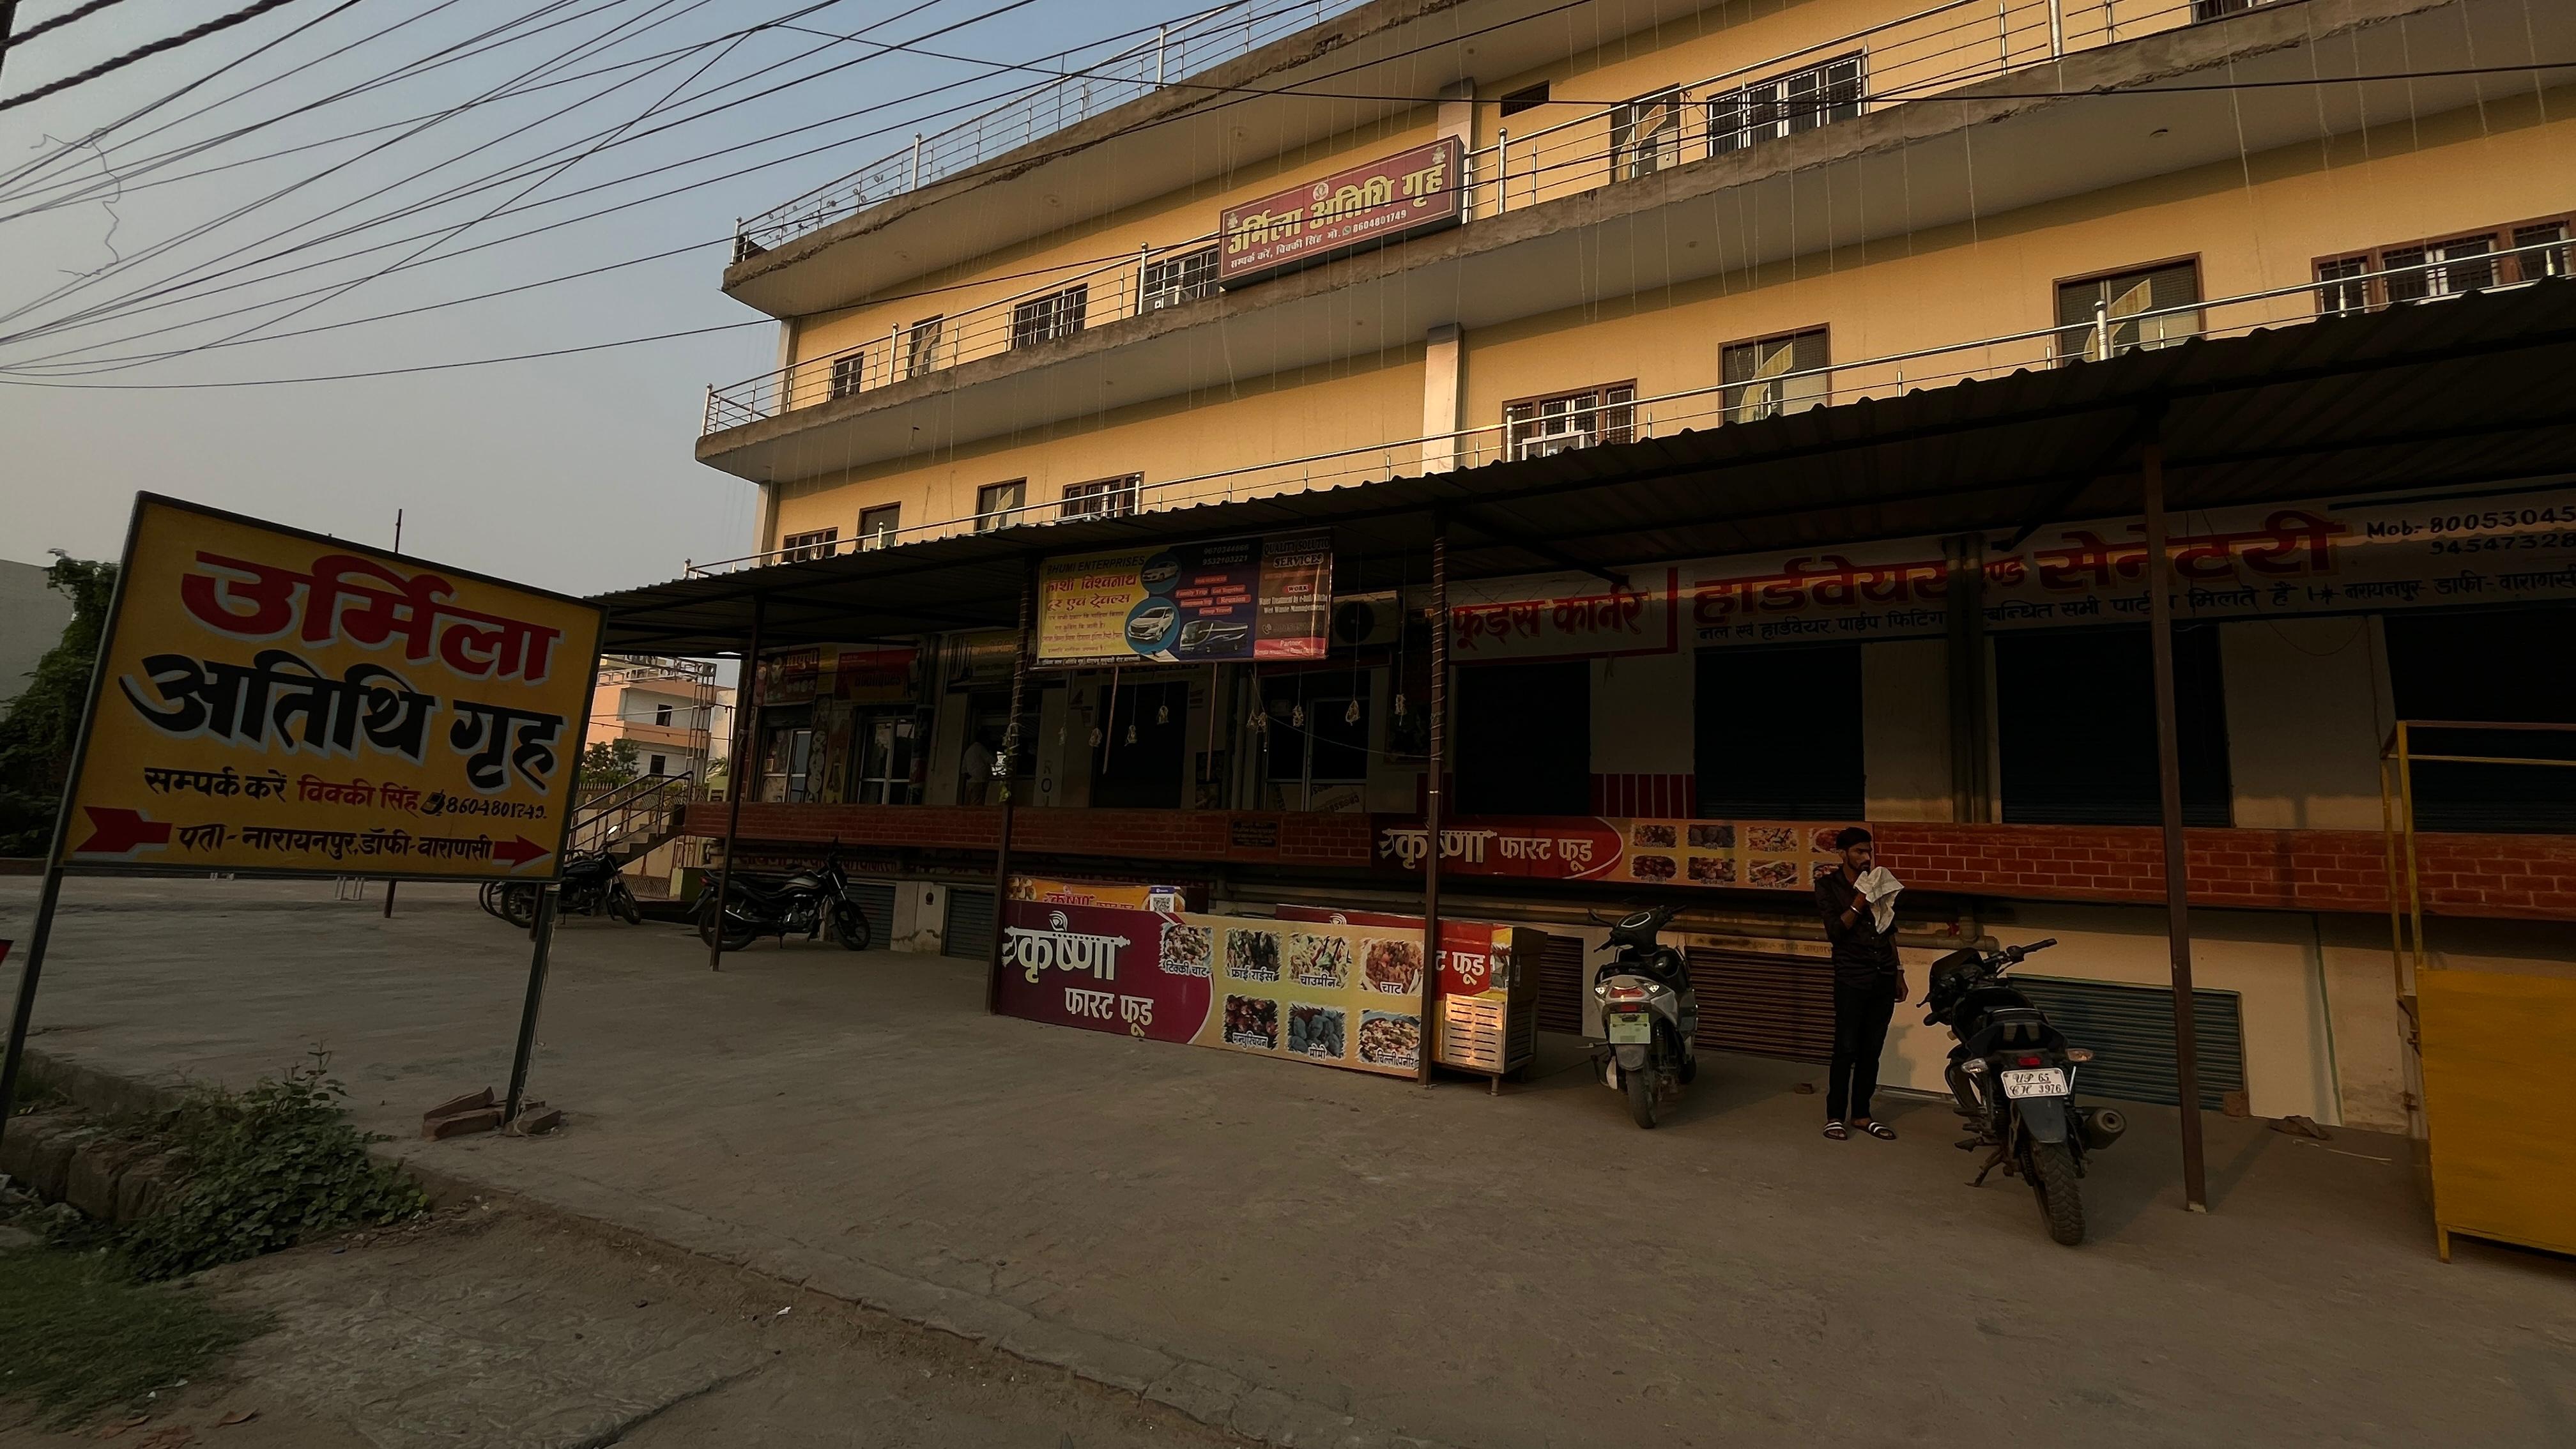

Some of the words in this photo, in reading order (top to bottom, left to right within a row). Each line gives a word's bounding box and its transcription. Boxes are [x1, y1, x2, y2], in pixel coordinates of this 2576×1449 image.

[1227, 207, 1305, 254] उर्मिला
[1402, 163, 1446, 208] गृह
[1230, 252, 1255, 268] सम्पर्क
[1353, 209, 1407, 233] 8604801749
[1047, 562, 1077, 574] BHUMI
[1078, 555, 1146, 572] ENTERPRISES
[1273, 553, 1324, 568] SERVICES
[1288, 585, 1309, 593] WORK
[181, 551, 562, 682] उर्मिला
[2059, 595, 2102, 617] सभी
[1450, 601, 1546, 650] फूड्स
[119, 649, 436, 763] अतिथि
[450, 699, 564, 791] गृह
[144, 767, 240, 797] सम्पर्क
[244, 769, 288, 802] करें
[297, 774, 376, 807] विक्की
[380, 782, 421, 818] सिंह
[1499, 836, 1552, 860] फास्ट
[1557, 838, 1594, 871] फूड
[1230, 965, 1250, 981] फ्राई
[1250, 966, 1275, 982] राईस
[1300, 971, 1337, 988] चाउमीन
[1452, 951, 1485, 986] फूड
[1381, 982, 1402, 994] चाट
[1064, 987, 1116, 1020] फास्ट
[1119, 995, 1154, 1038] फूड
[1308, 1043, 1326, 1059] मोमो
[1376, 1049, 1397, 1066] चिल्ली
[2038, 1073, 2050, 1082] 65
